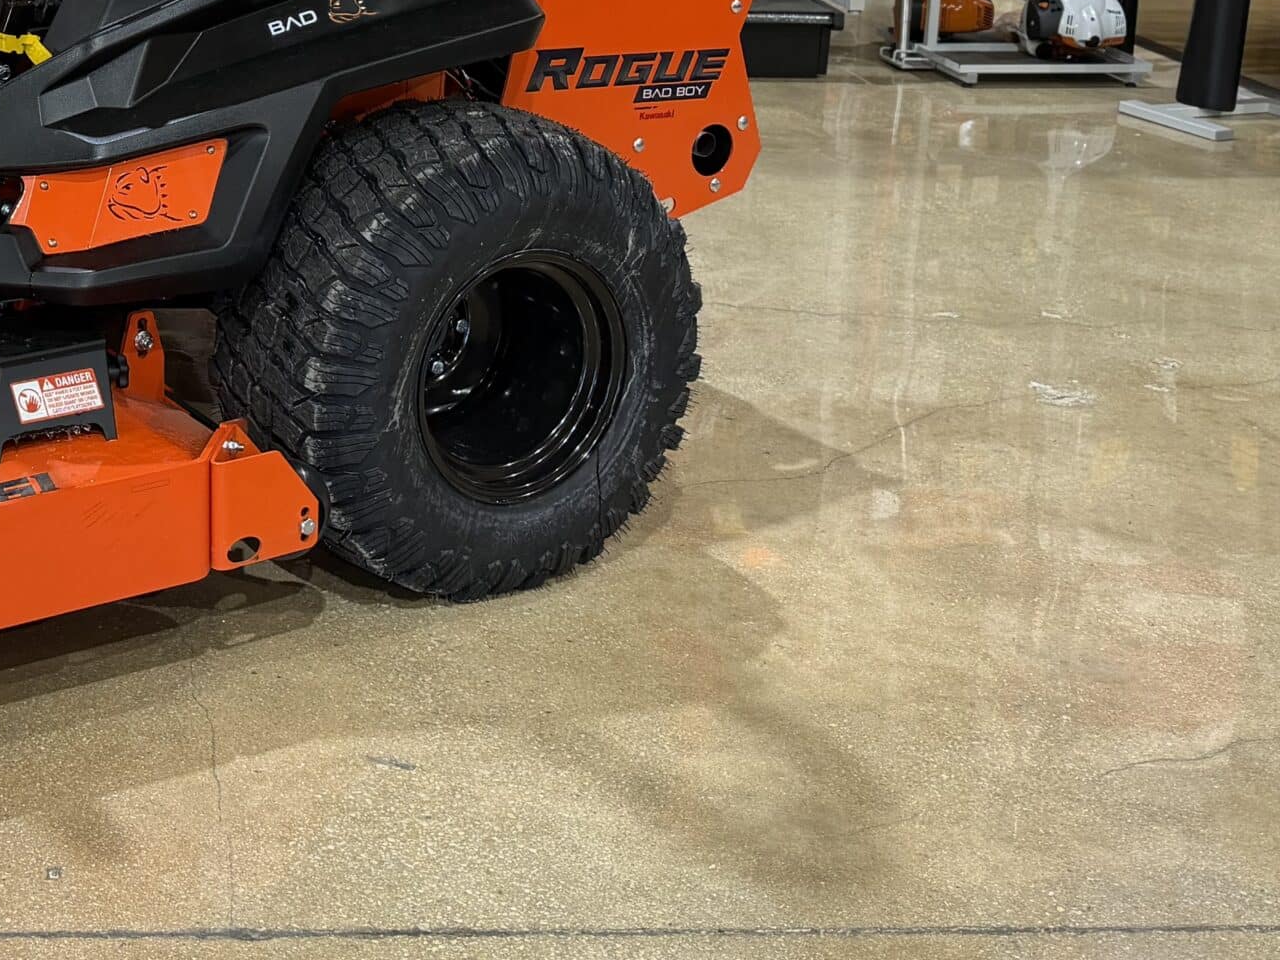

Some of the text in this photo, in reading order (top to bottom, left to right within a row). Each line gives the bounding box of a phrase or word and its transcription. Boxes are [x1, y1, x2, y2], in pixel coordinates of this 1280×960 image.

[268, 10, 318, 36] BAD
[525, 47, 731, 92] ROGUE
[642, 85, 706, 99] BAD BOY
[639, 109, 675, 120] Kawasaki
[55, 372, 93, 387] DANGER
